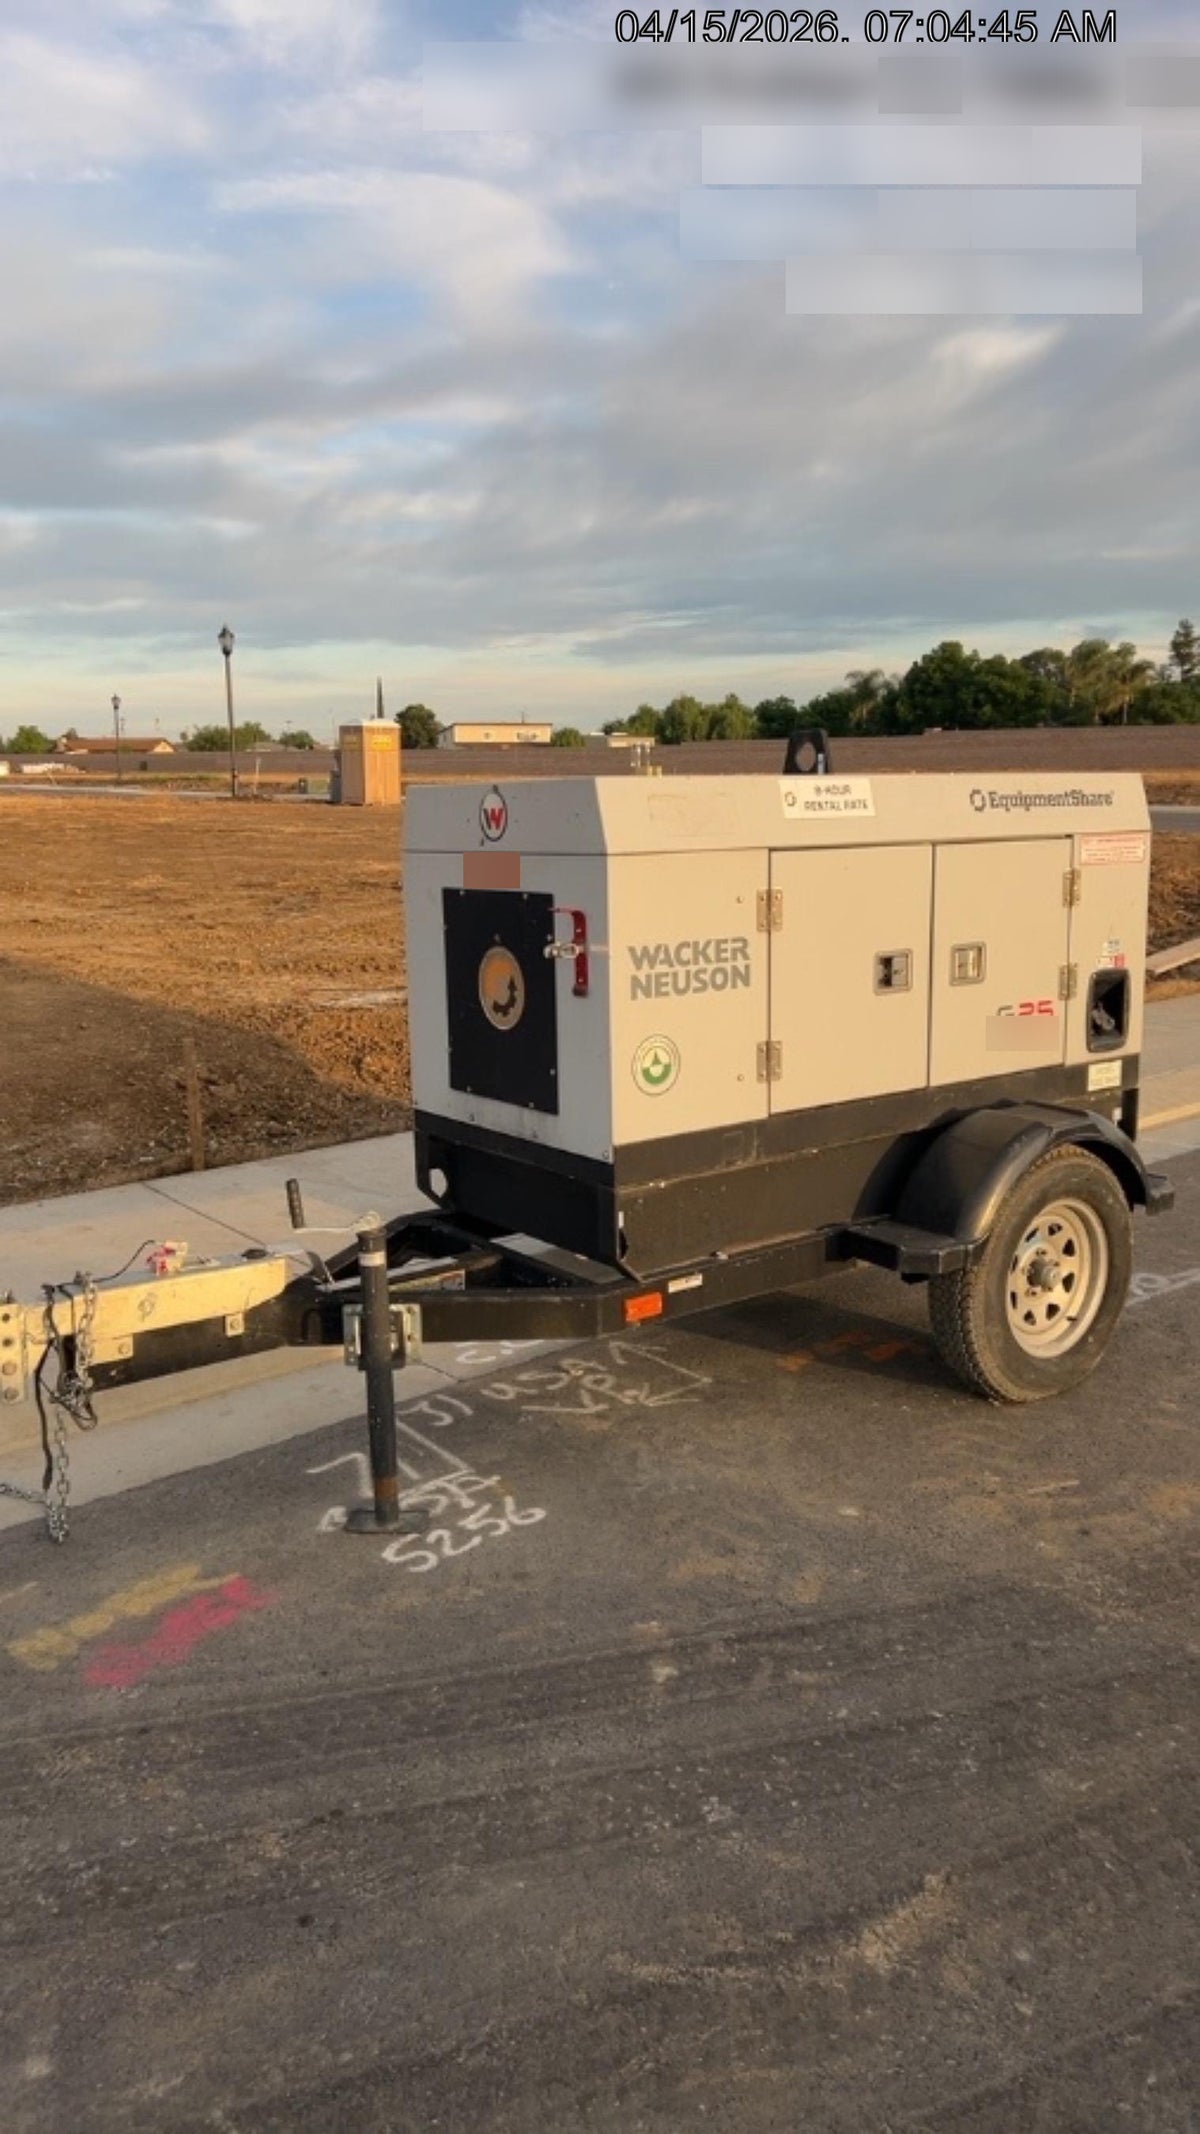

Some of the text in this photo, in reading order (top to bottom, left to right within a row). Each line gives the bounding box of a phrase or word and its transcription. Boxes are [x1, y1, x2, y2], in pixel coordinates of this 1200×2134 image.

[988, 788, 1113, 812] EquipmentShare
[627, 936, 750, 971] WACKER
[630, 964, 751, 1001] NEUSON
[381, 1496, 546, 1573] 5256
